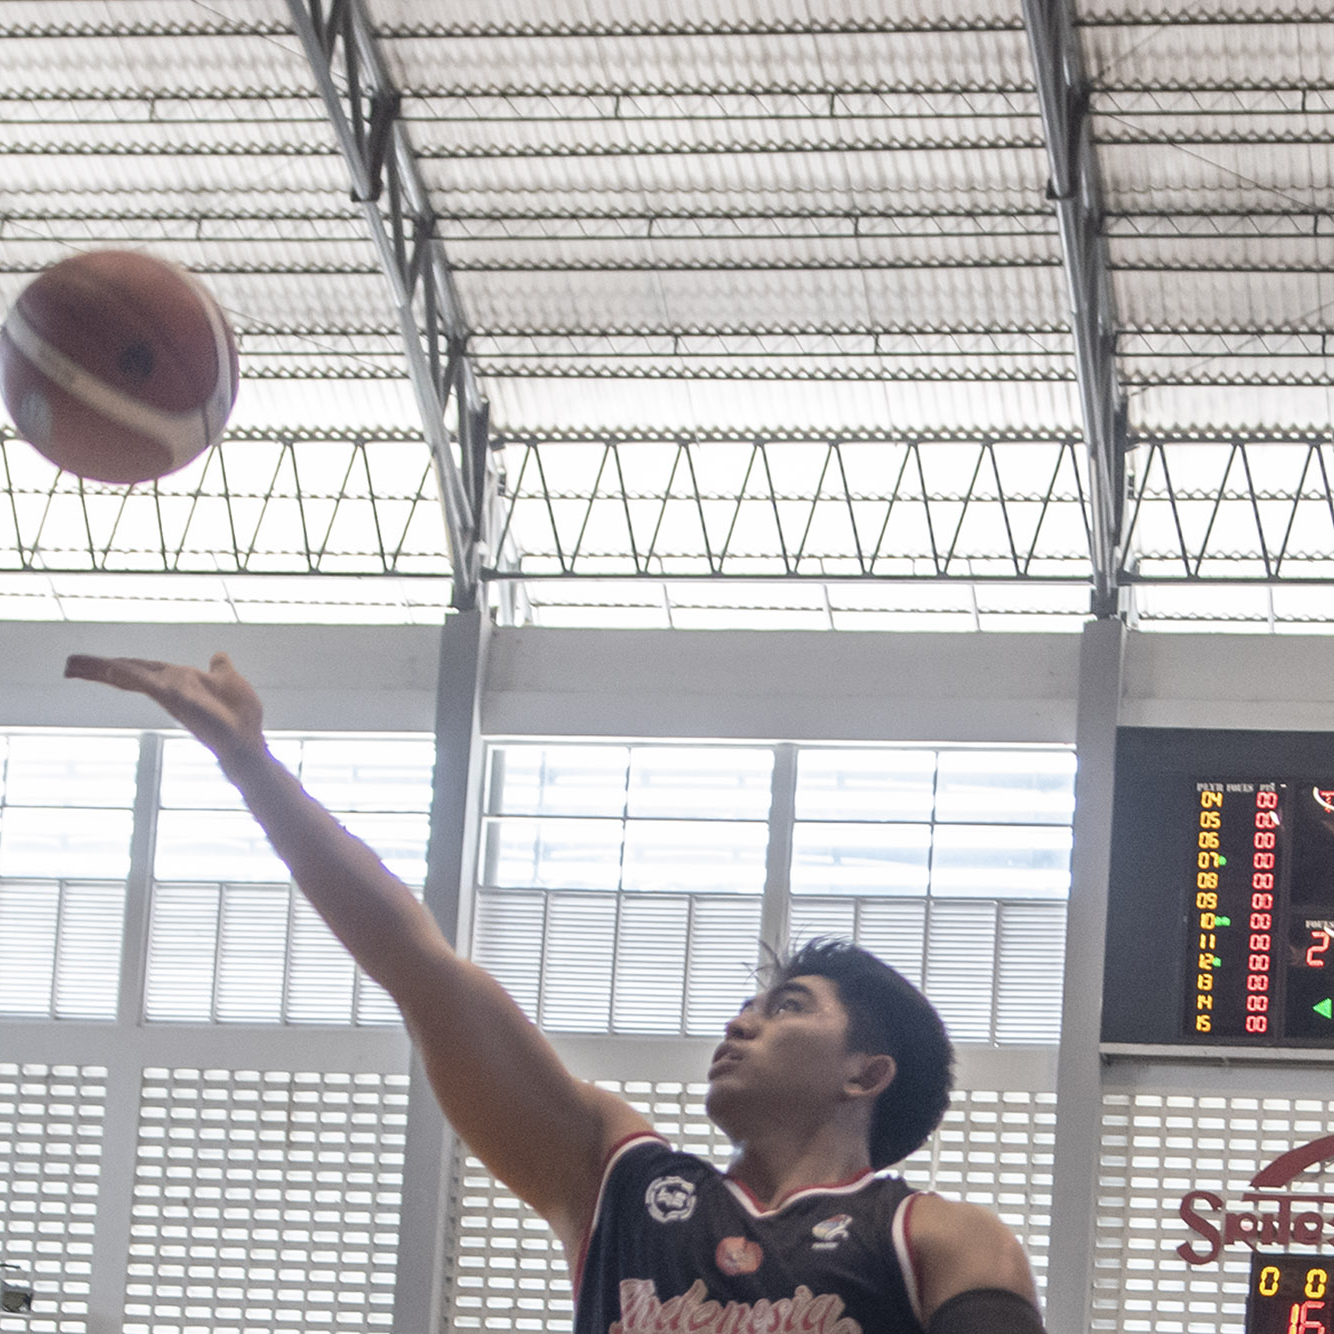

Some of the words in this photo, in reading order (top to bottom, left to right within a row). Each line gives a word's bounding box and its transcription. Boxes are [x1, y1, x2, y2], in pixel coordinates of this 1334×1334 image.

[1201, 791, 1223, 808] 04
[1256, 792, 1278, 809] 00
[1200, 811, 1221, 829] 05
[1255, 811, 1277, 829] 00
[1198, 831, 1220, 849] 06
[1254, 831, 1276, 849] 00
[1198, 851, 1220, 869] 07
[1253, 852, 1275, 869] 00
[1197, 872, 1219, 889] 08
[1252, 872, 1274, 890] 00
[1252, 893, 1274, 910] 00
[1250, 913, 1272, 930] 00
[1200, 933, 1216, 949] 11
[1250, 934, 1271, 951] 00
[1306, 931, 1330, 967] 2
[1249, 954, 1271, 971] 00
[1247, 974, 1269, 991] 00
[1247, 995, 1269, 1012] 00
[1246, 1015, 1268, 1033] 00
[1259, 1266, 1280, 1296] 0
[1304, 1268, 1328, 1299] 0
